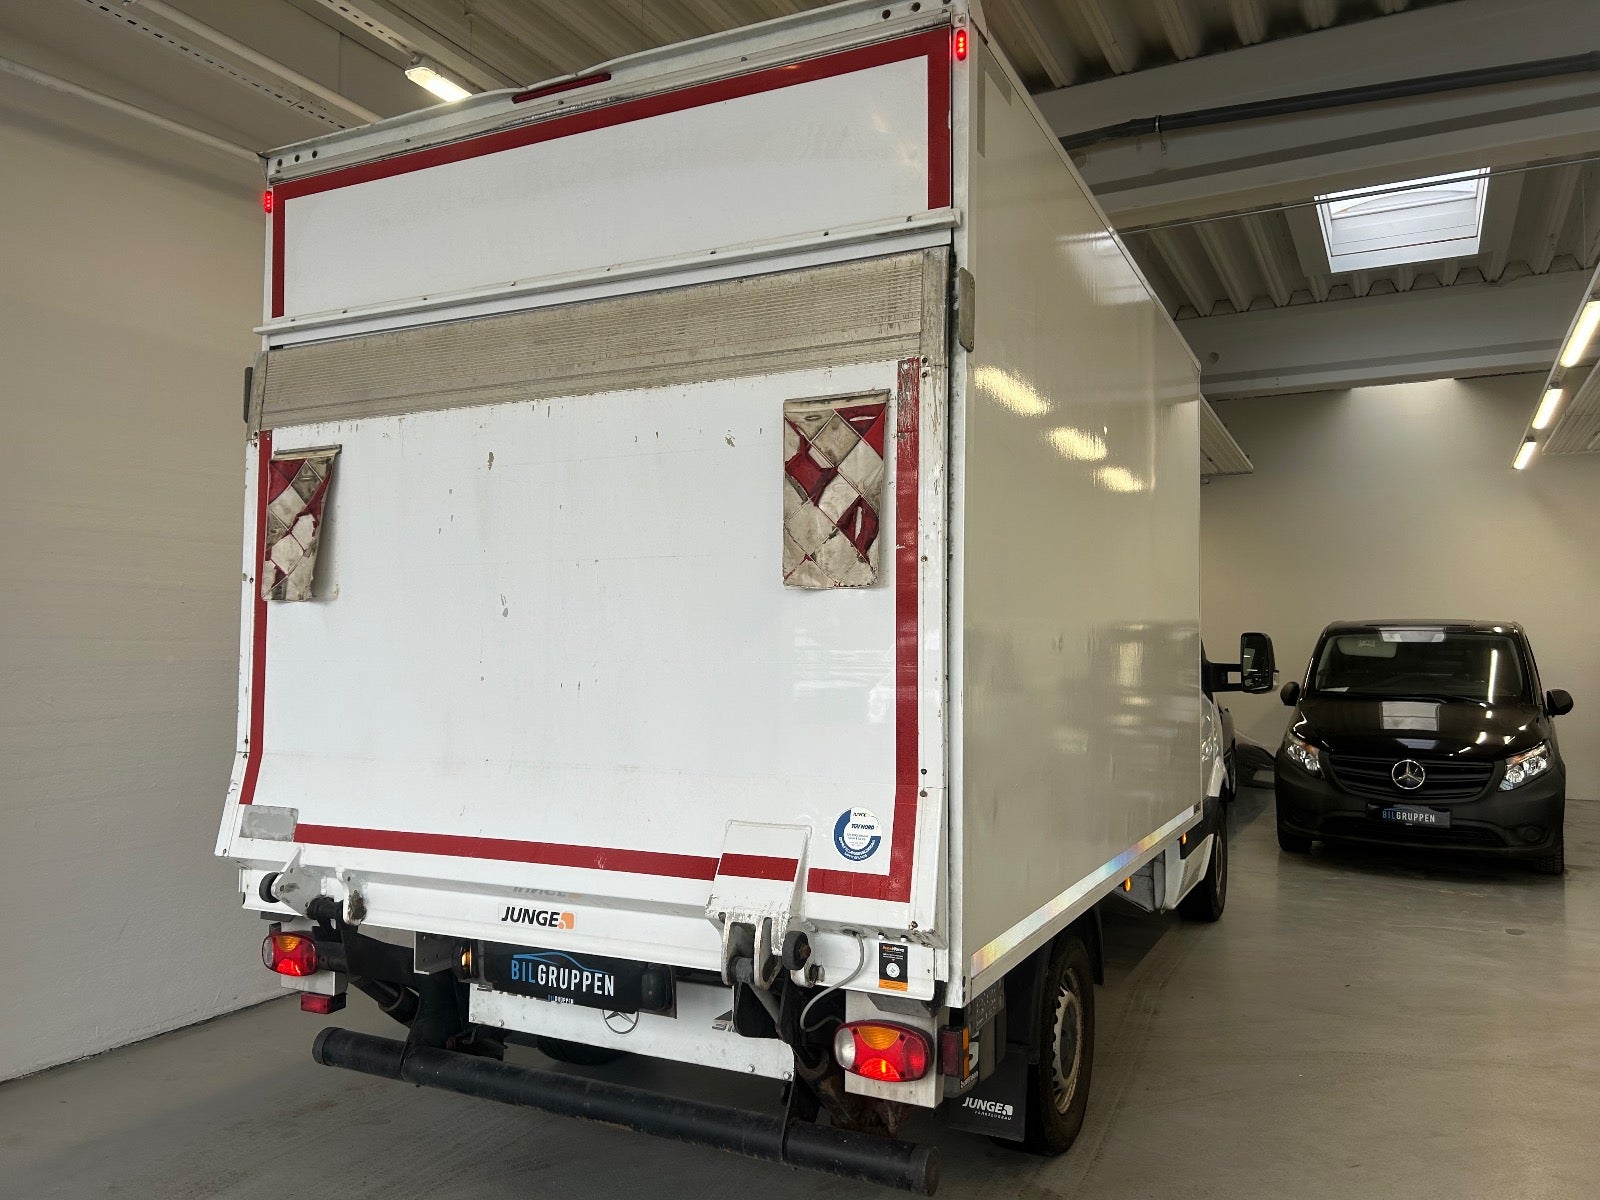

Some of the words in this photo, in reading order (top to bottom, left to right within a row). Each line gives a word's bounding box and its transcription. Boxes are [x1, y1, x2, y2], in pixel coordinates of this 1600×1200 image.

[1382, 810, 1435, 823] BILGRUPPEN
[501, 906, 560, 928] JUNGE
[511, 959, 615, 997] BILGRUPPEN
[962, 1096, 1004, 1114] JUNGE
